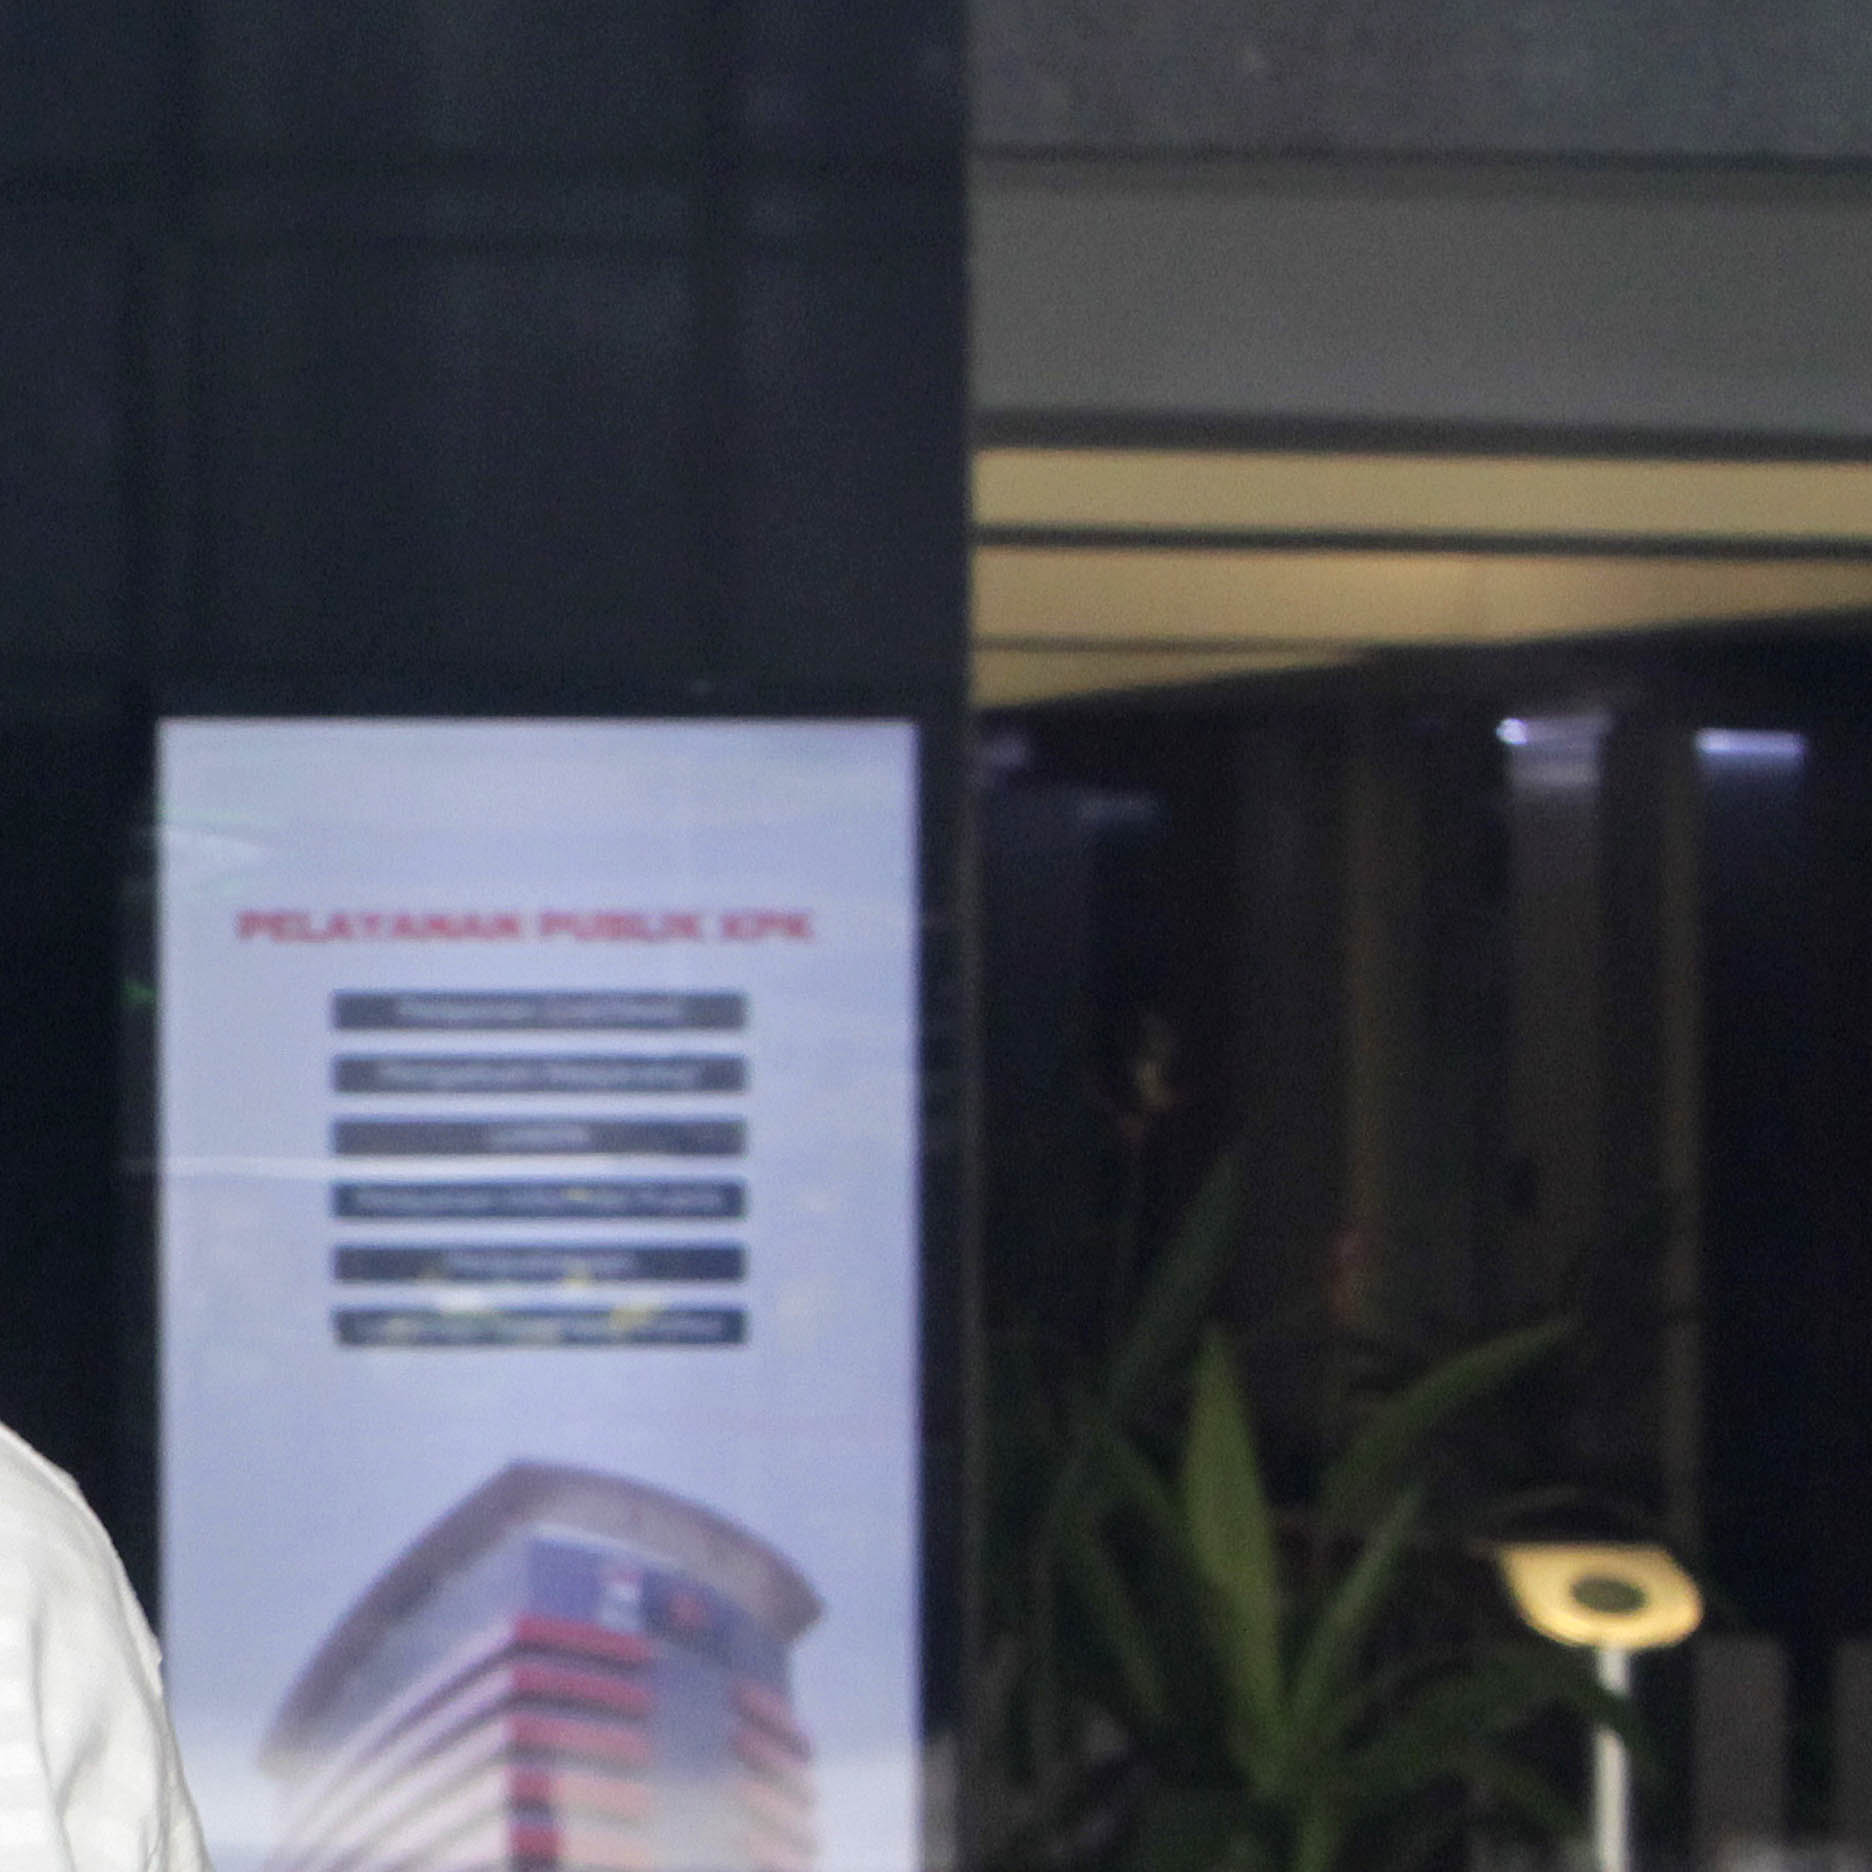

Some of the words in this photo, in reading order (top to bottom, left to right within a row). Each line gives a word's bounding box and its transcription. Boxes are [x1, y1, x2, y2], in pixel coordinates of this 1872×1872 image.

[238, 910, 520, 942] PELAYANAN
[539, 910, 703, 942] PUBLIK
[720, 909, 815, 942] KPK
